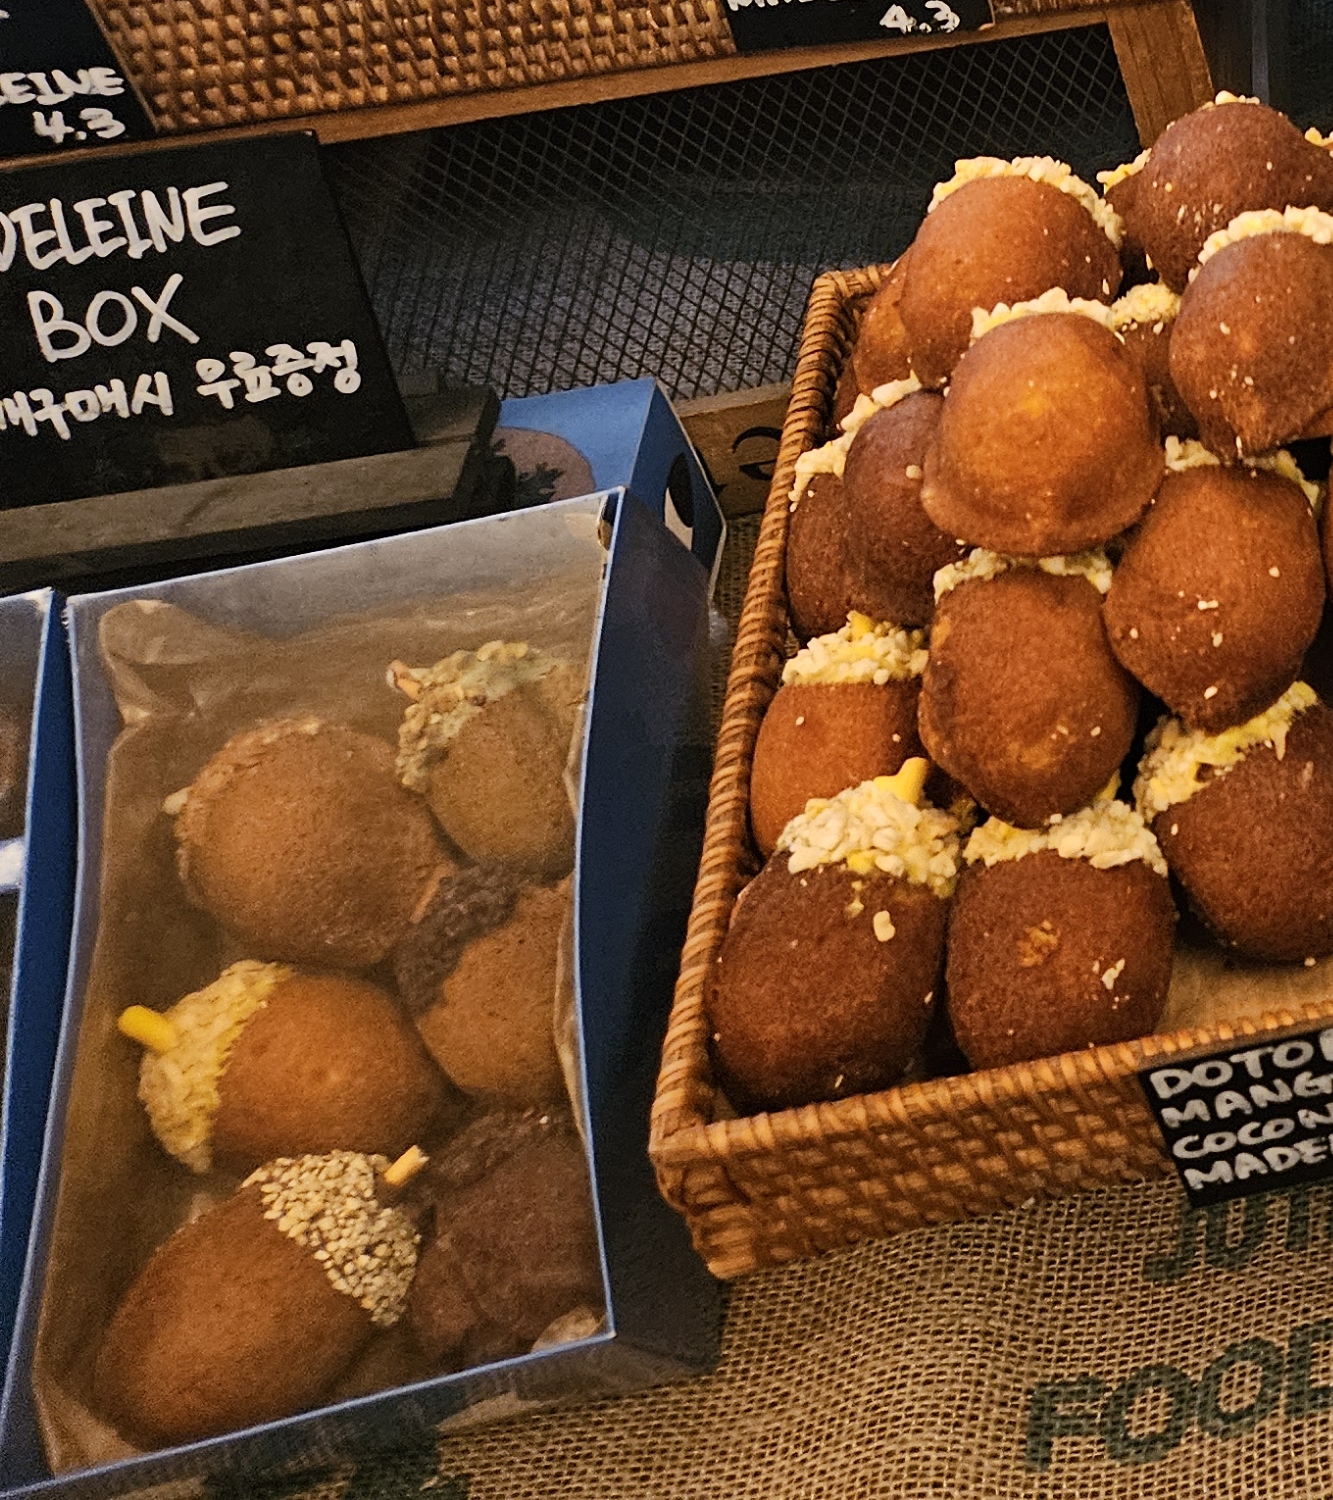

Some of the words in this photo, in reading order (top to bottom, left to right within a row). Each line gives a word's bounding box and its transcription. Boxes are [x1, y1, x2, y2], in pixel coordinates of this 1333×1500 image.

[879, 0, 961, 34] 4.3
[0, 66, 125, 106] EINE
[32, 107, 126, 144] 4.3
[26, 273, 200, 363] BOX
